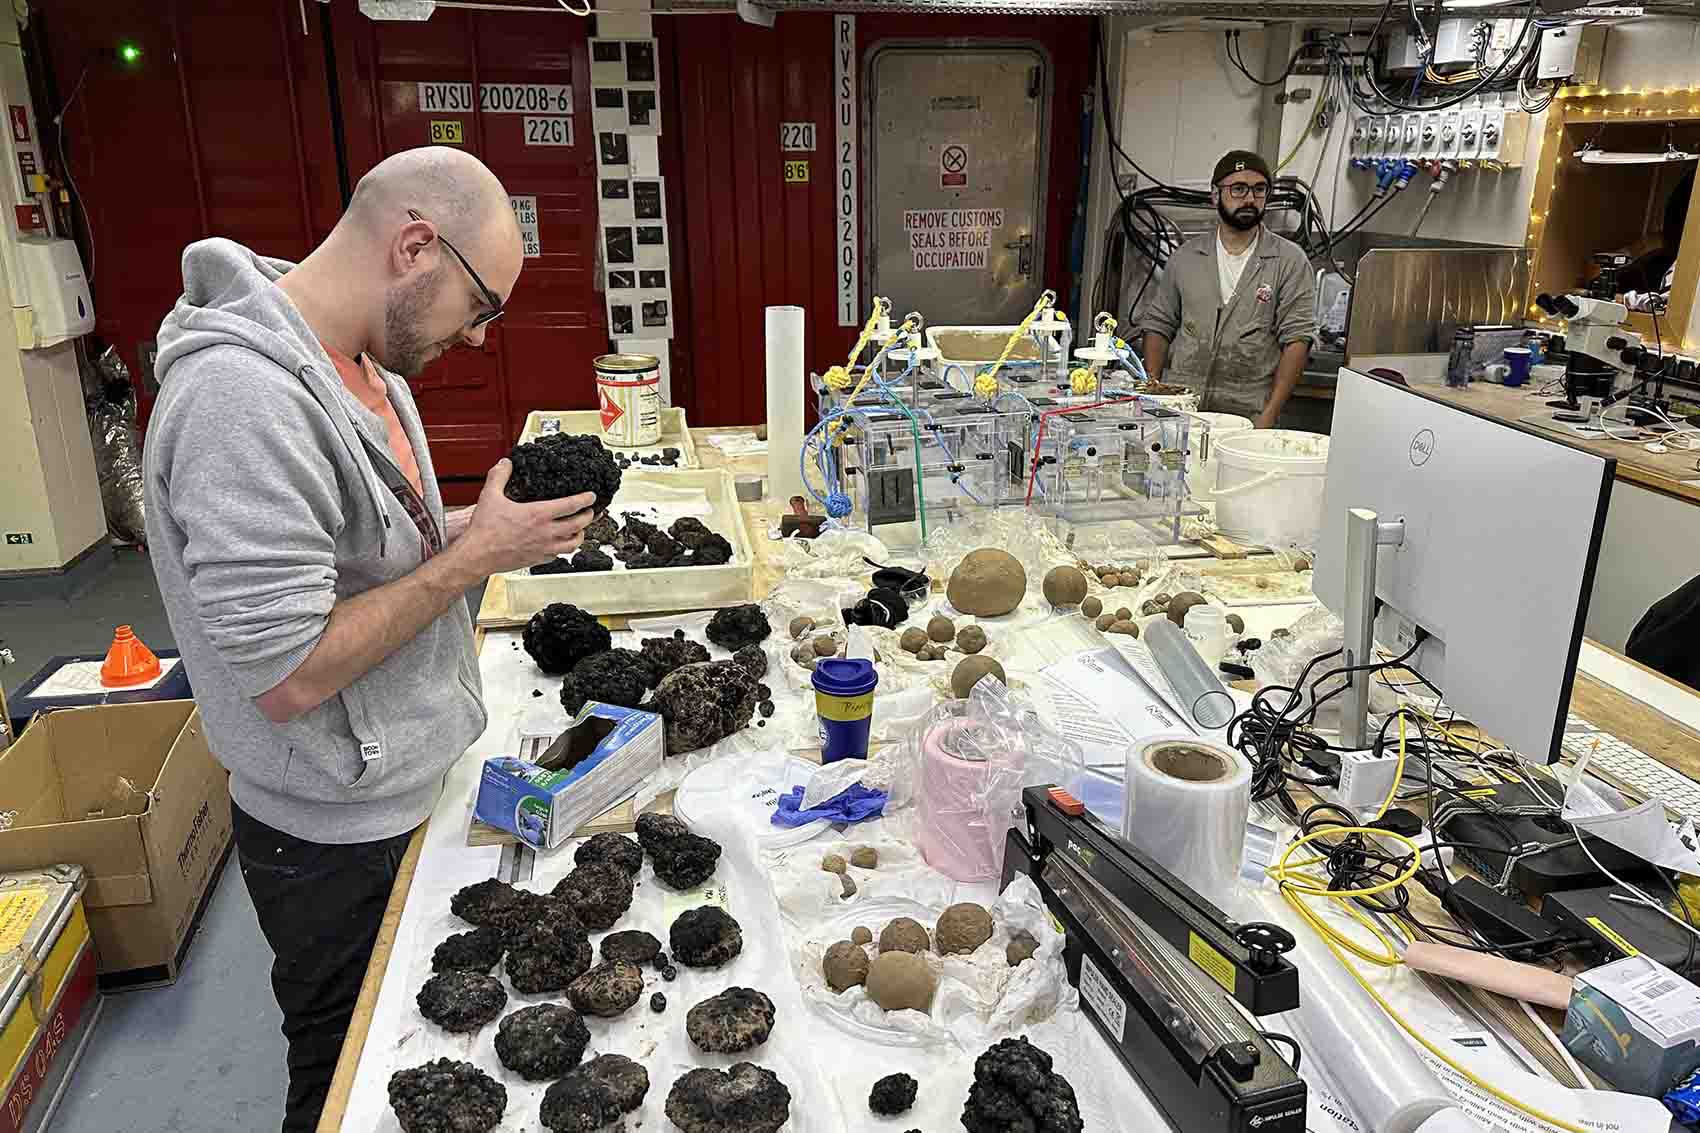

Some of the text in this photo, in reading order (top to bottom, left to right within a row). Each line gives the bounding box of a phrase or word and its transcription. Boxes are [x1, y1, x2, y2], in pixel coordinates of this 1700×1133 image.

[841, 19, 851, 126] RVSU
[425, 86, 568, 111] RVSU 200208-6
[432, 124, 460, 140] 8'6"
[527, 119, 569, 142] 22G1
[520, 199, 531, 210] KG
[520, 212, 536, 224] LBS
[905, 210, 1002, 229] REMOVE CUSTOMS
[522, 231, 533, 242] KG
[912, 230, 990, 249] SEALS BEFORE
[523, 243, 539, 255] LBS
[915, 250, 984, 268] OCCUPATION
[1413, 440, 1430, 456] DELL
[1605, 1122, 1620, 1131] not
